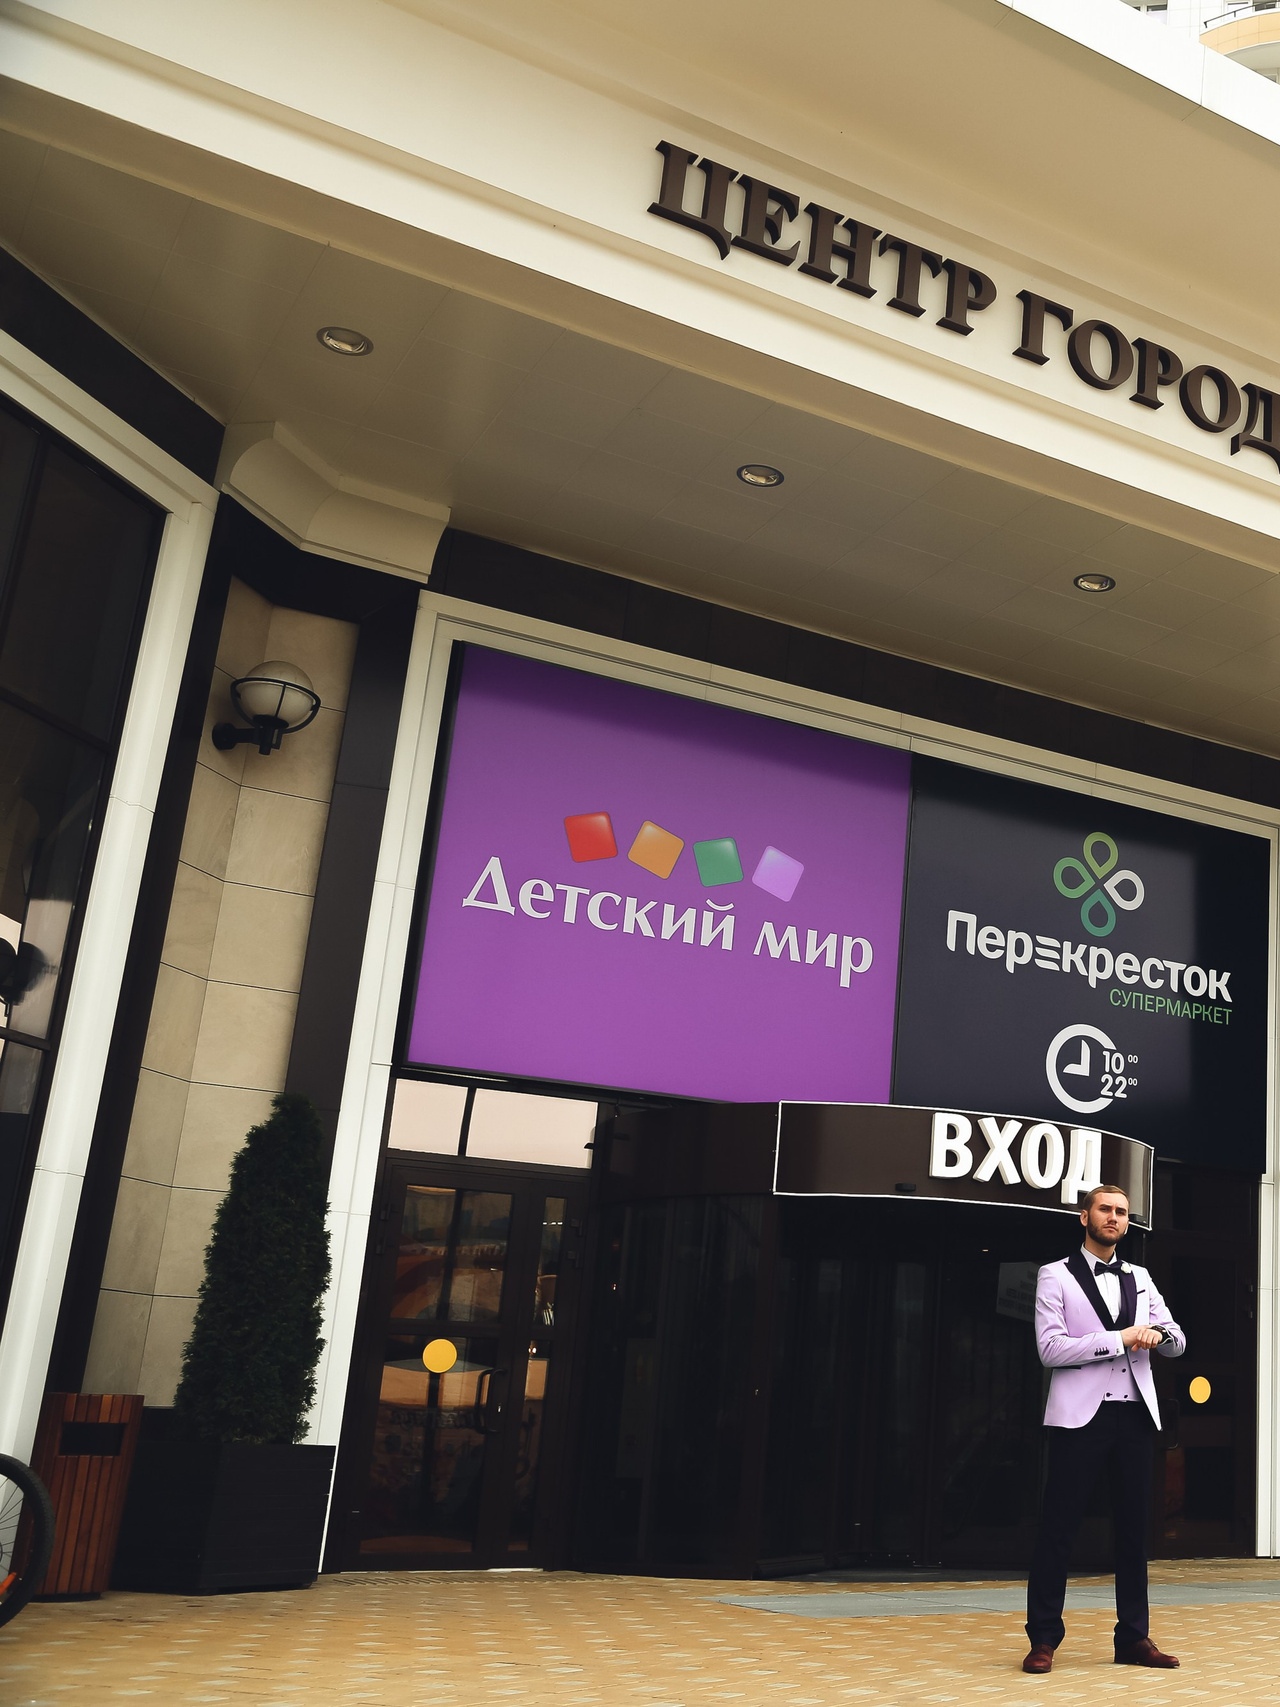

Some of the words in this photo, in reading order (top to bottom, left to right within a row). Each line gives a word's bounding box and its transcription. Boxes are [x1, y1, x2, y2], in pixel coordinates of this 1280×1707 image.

[647, 140, 997, 337] ЦЕНТР
[462, 856, 735, 951] Детский
[753, 921, 874, 988] мир
[946, 910, 1233, 1002] Перекресток
[1109, 988, 1233, 1025] СУПЕРМАРКЕТ
[929, 1112, 1104, 1204] ВХОД
